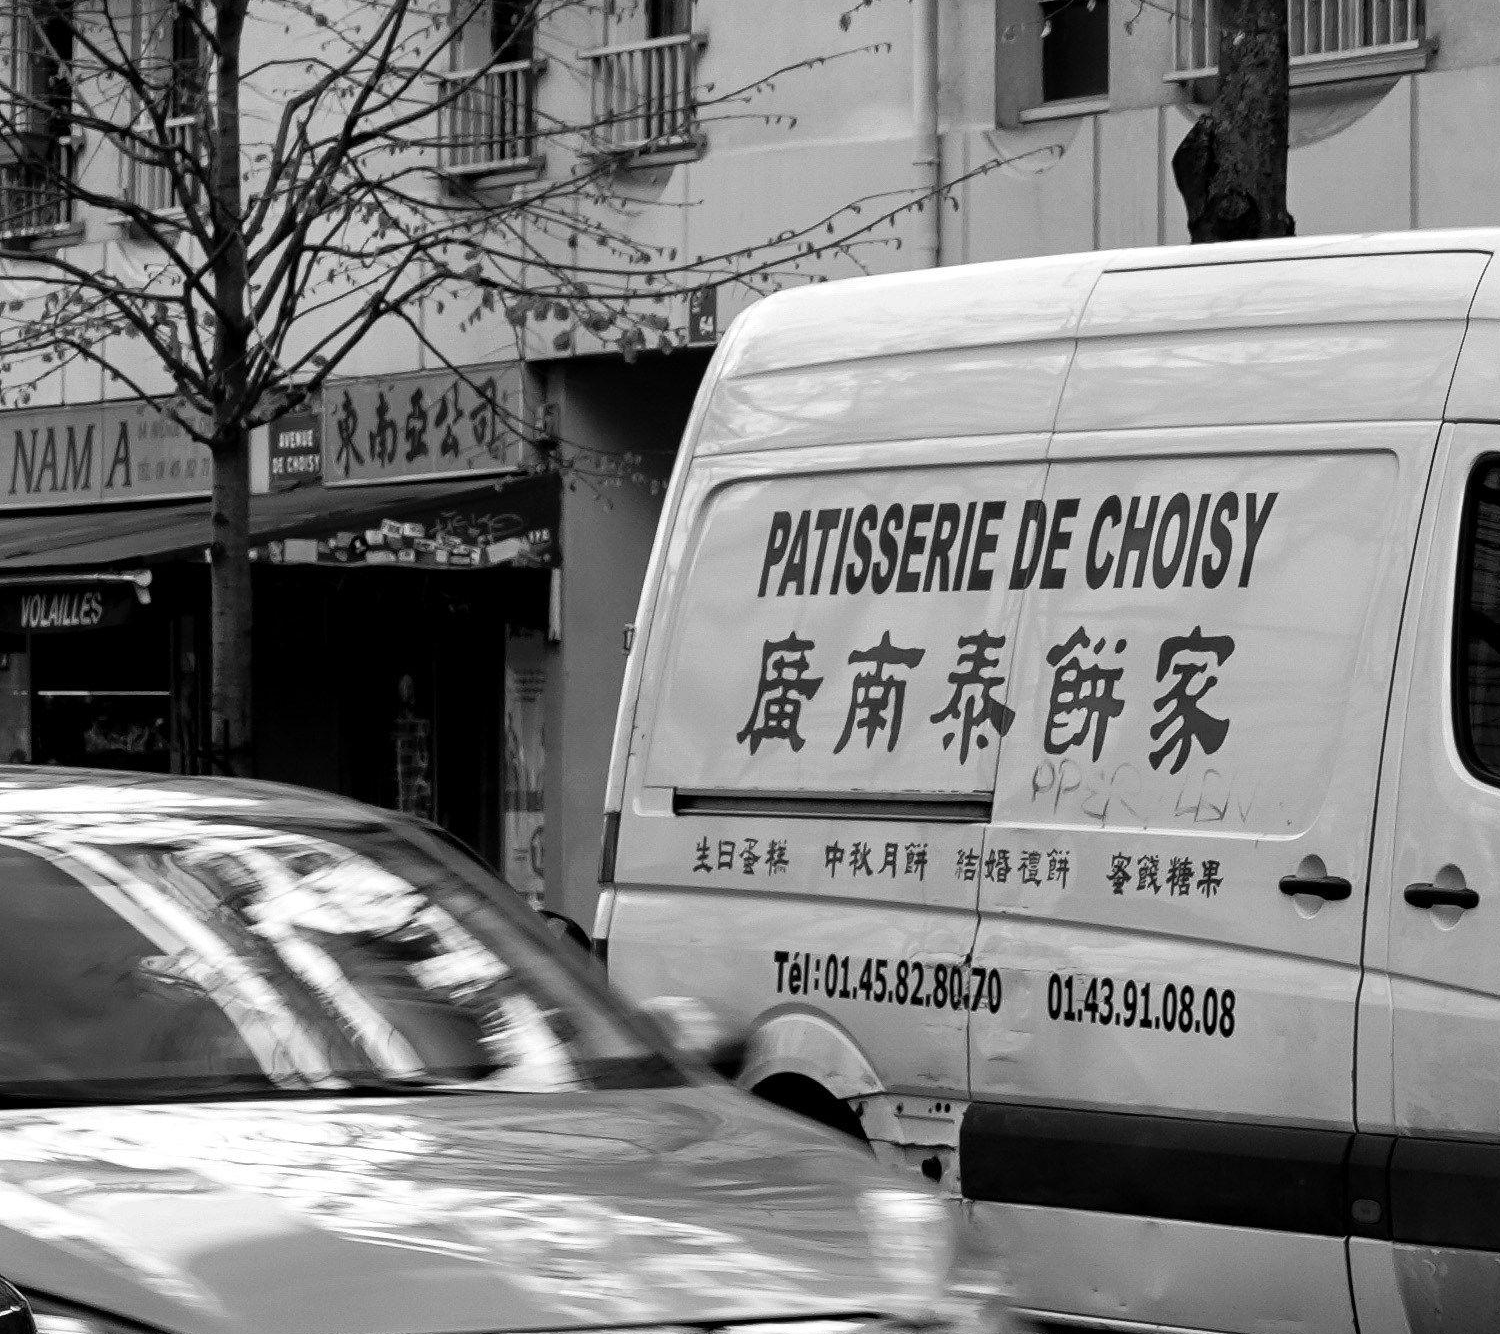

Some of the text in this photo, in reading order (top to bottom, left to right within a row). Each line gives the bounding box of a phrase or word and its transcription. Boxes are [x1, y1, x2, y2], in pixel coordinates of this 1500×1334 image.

[8, 420, 132, 496] NAM A
[279, 429, 313, 448] AVENUE
[335, 376, 497, 478] 東南亞公司
[757, 491, 1279, 597] PATISSERIE DE CHOISY
[20, 591, 103, 628] VOLAILLES
[736, 625, 1236, 775] 廣南泰餅家
[693, 836, 789, 875] 生日蛋糕
[823, 840, 928, 881] 中秋月餅
[955, 847, 1071, 889] 結婚禮餅
[1047, 973, 1236, 1038] 01.43.91.08.08
